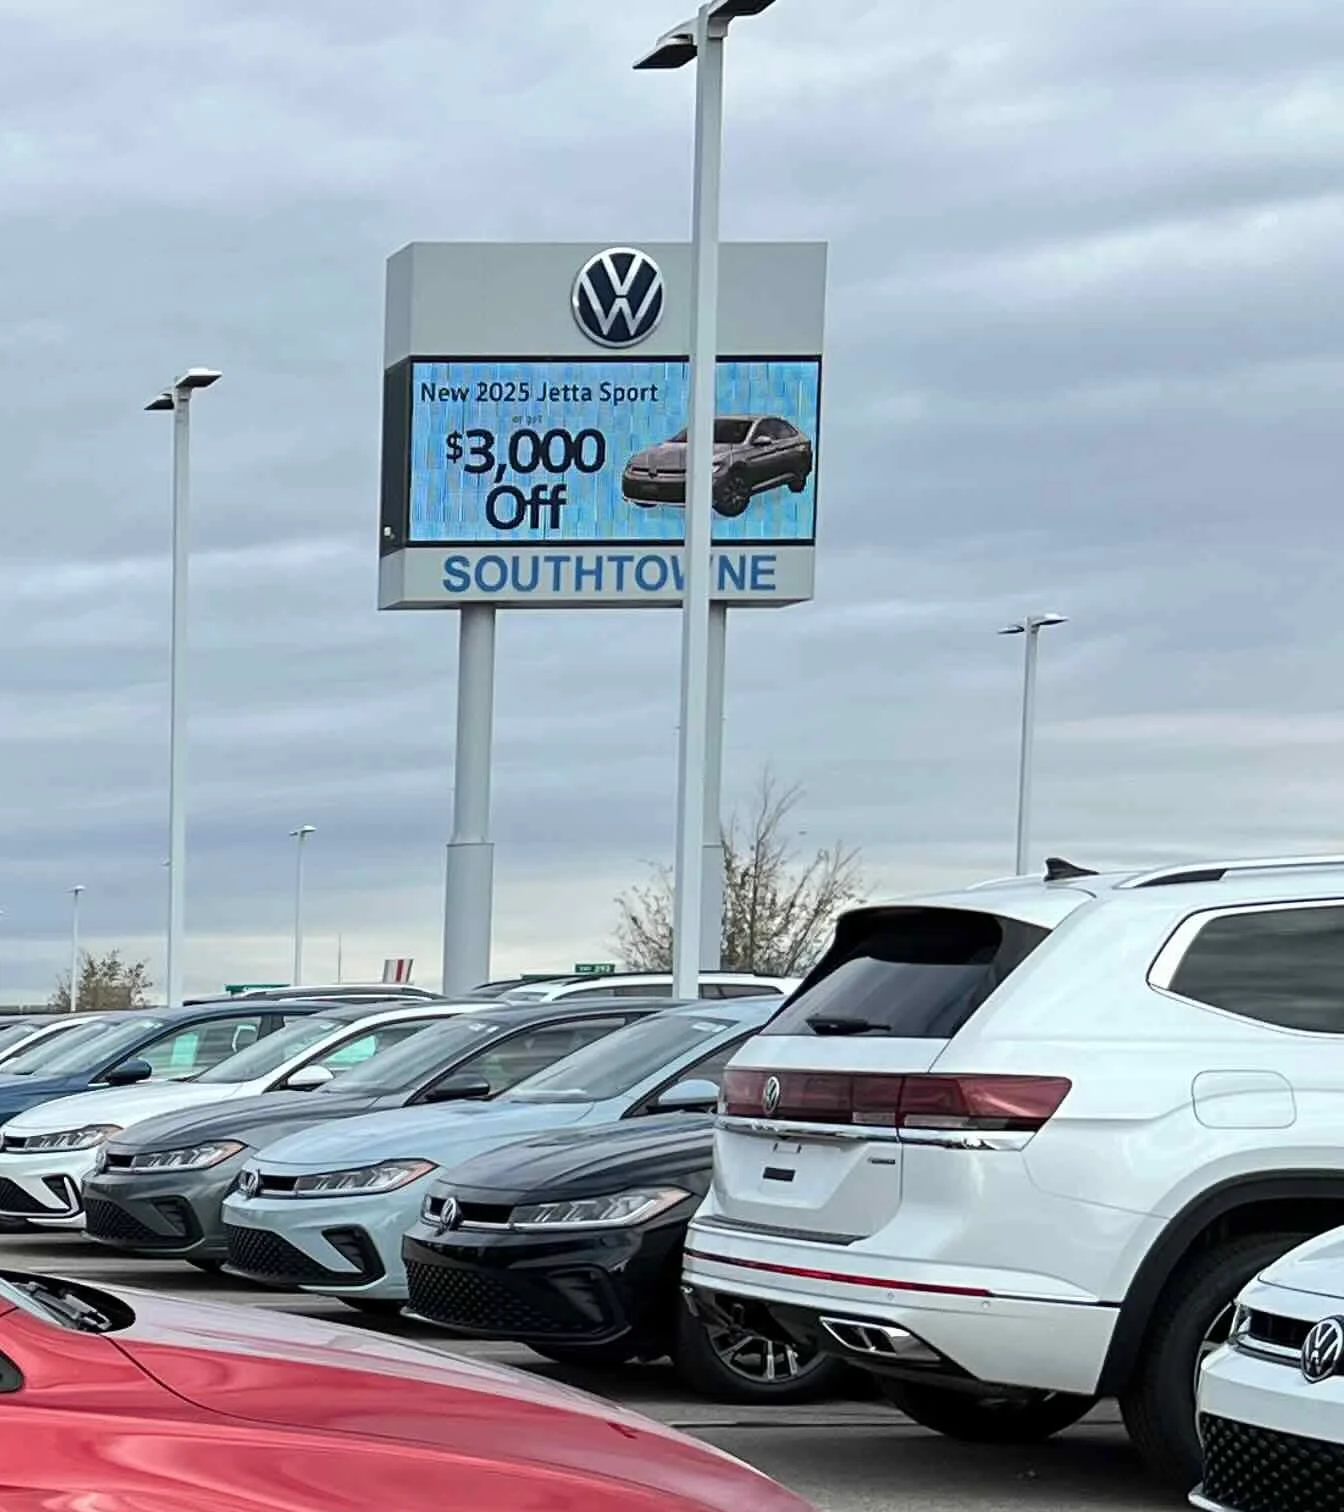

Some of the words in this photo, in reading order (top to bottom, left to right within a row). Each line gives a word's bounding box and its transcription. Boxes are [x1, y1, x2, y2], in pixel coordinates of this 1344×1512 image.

[572, 247, 664, 346] VW
[421, 383, 470, 401] New
[477, 383, 530, 401] 2025
[537, 382, 593, 401] Jetta
[599, 382, 659, 406] Sport
[446, 428, 606, 483] $3,000
[486, 484, 567, 530] Off
